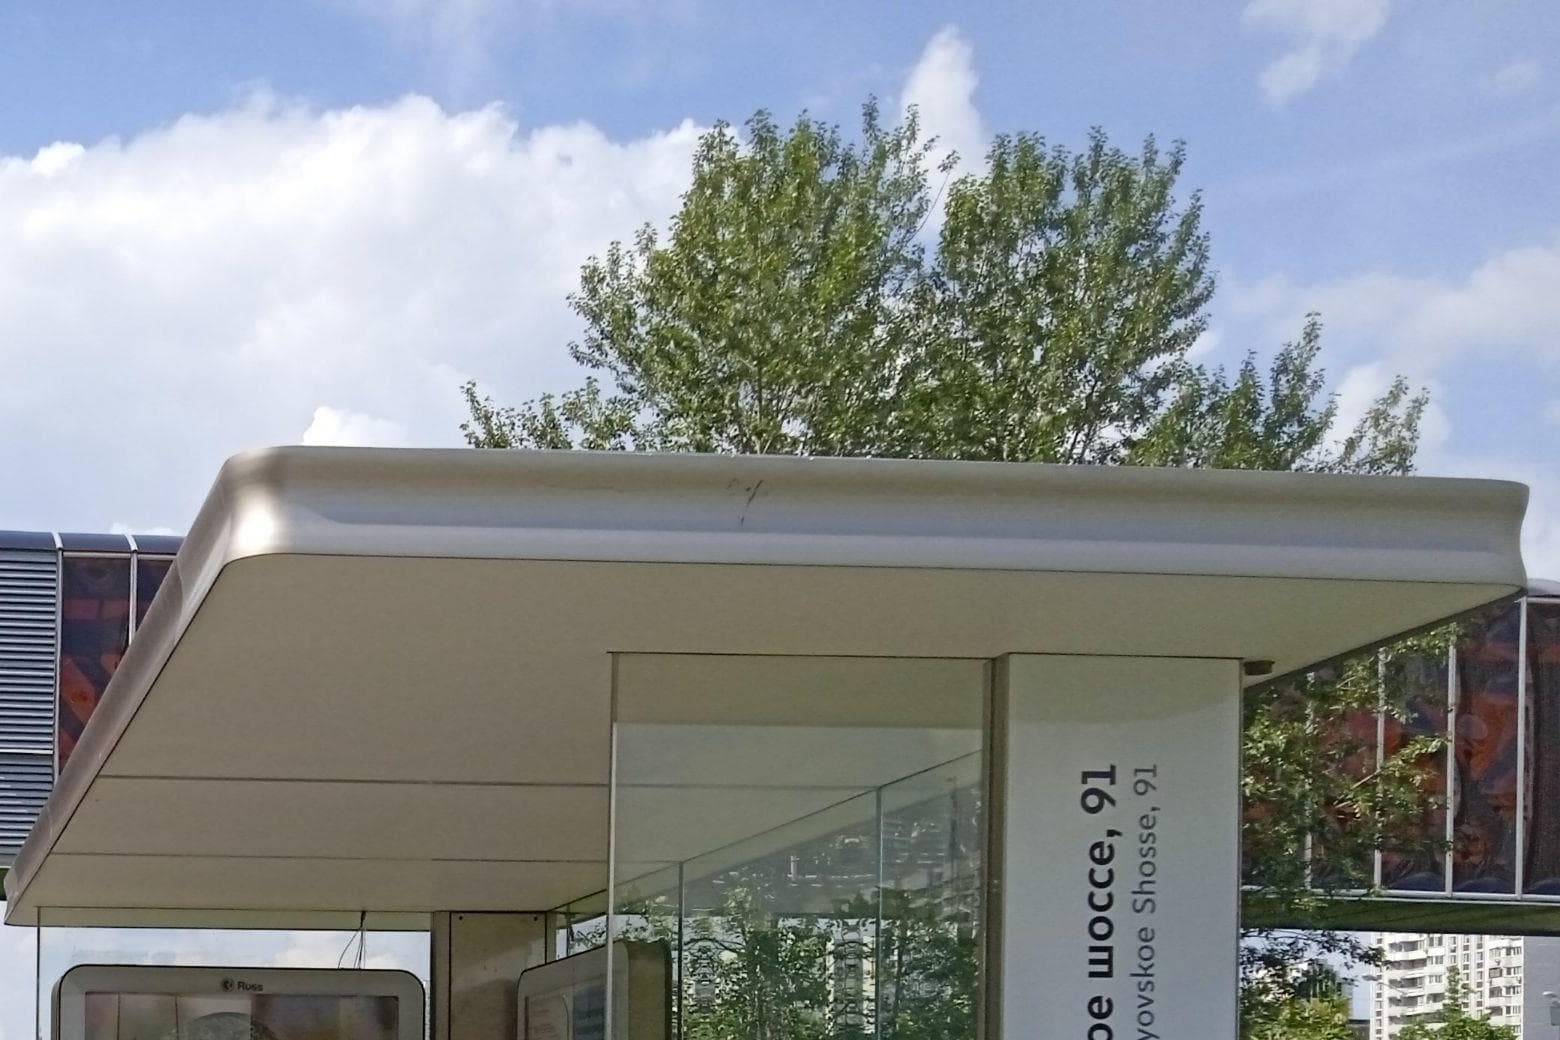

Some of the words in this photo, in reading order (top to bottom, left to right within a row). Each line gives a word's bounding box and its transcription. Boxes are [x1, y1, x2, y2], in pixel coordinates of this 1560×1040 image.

[1080, 764, 1117, 815] 91
[1133, 764, 1157, 796] 91
[1132, 805, 1161, 914] Shosse,
[1087, 828, 1123, 978] шоссе,
